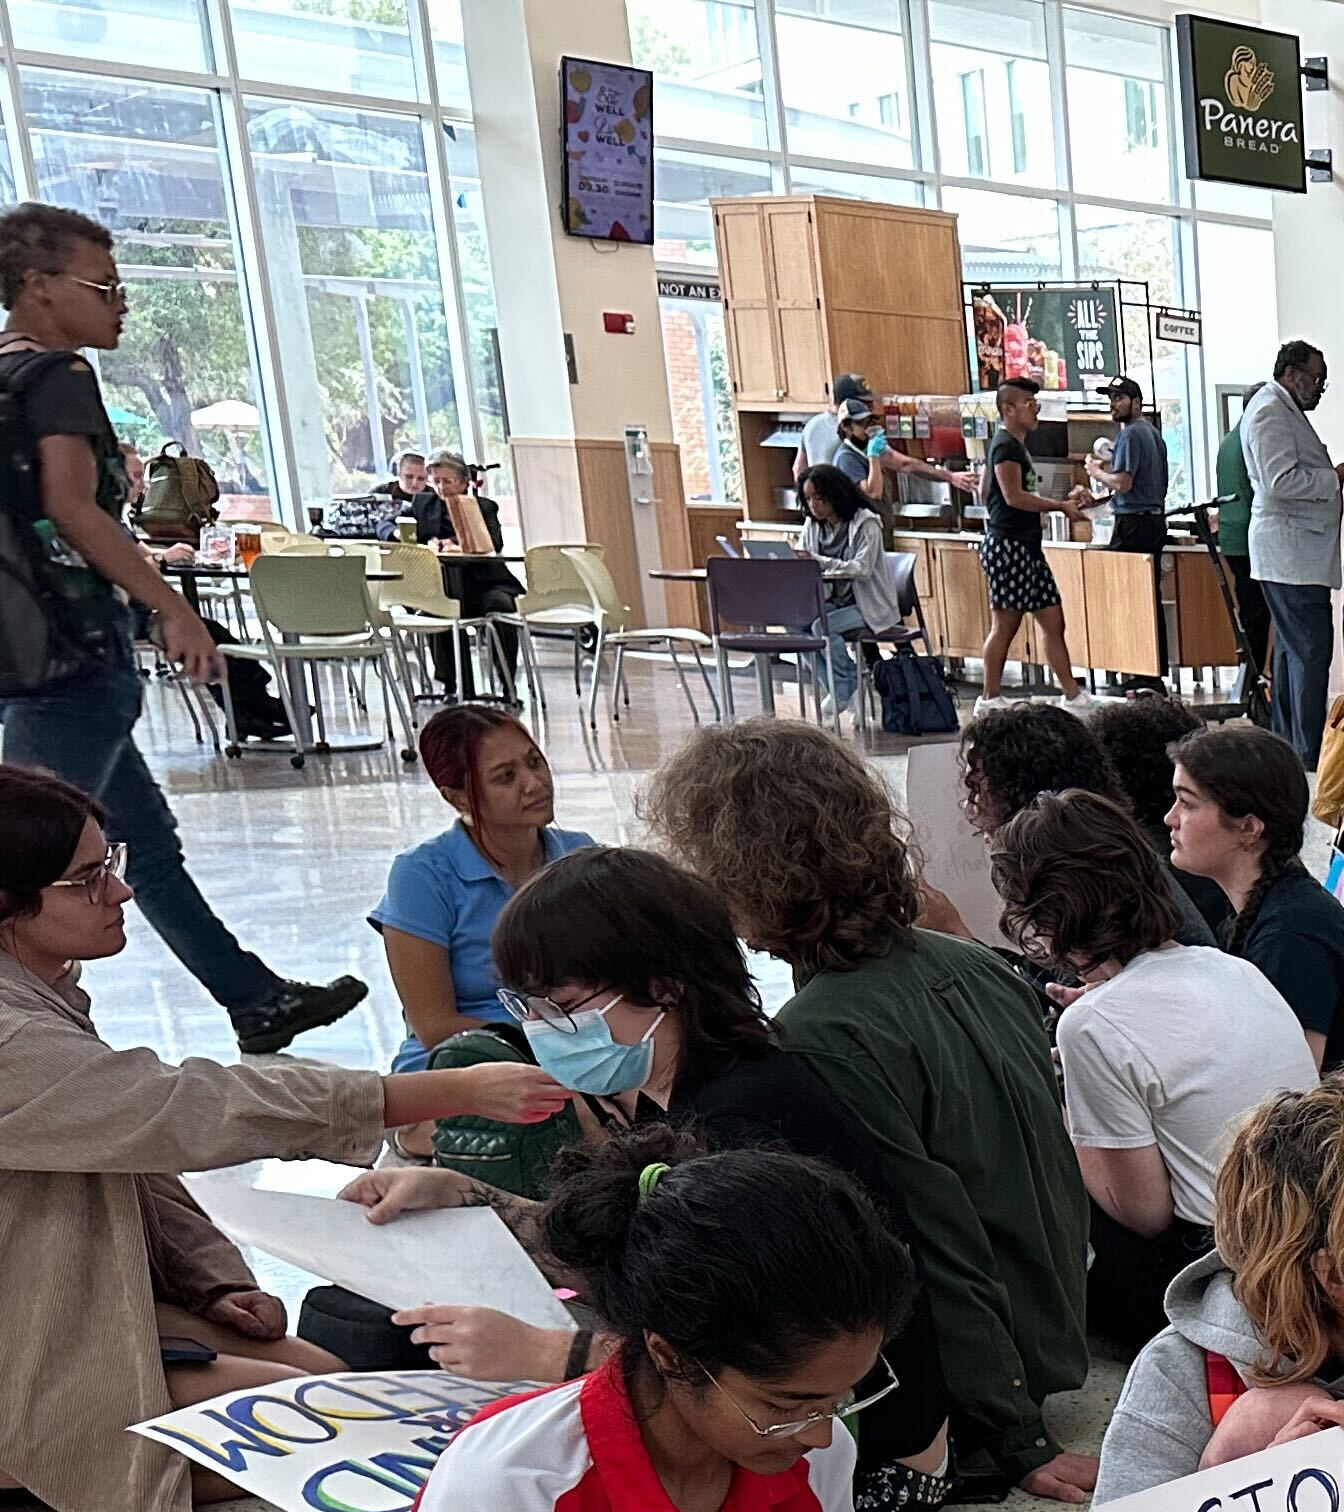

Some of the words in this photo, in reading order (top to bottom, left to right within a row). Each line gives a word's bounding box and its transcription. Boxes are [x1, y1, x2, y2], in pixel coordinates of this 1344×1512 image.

[595, 104, 624, 116] WELL
[1200, 98, 1298, 143] Panera
[595, 134, 625, 146] WELL
[1224, 135, 1279, 154] BREAD
[660, 283, 685, 296] NOT
[689, 286, 706, 297] AN
[1077, 300, 1101, 328] ALL
[1164, 323, 1195, 336] COFFEE
[1076, 341, 1105, 370] SIPS
[147, 1371, 535, 1473] EEDOM
